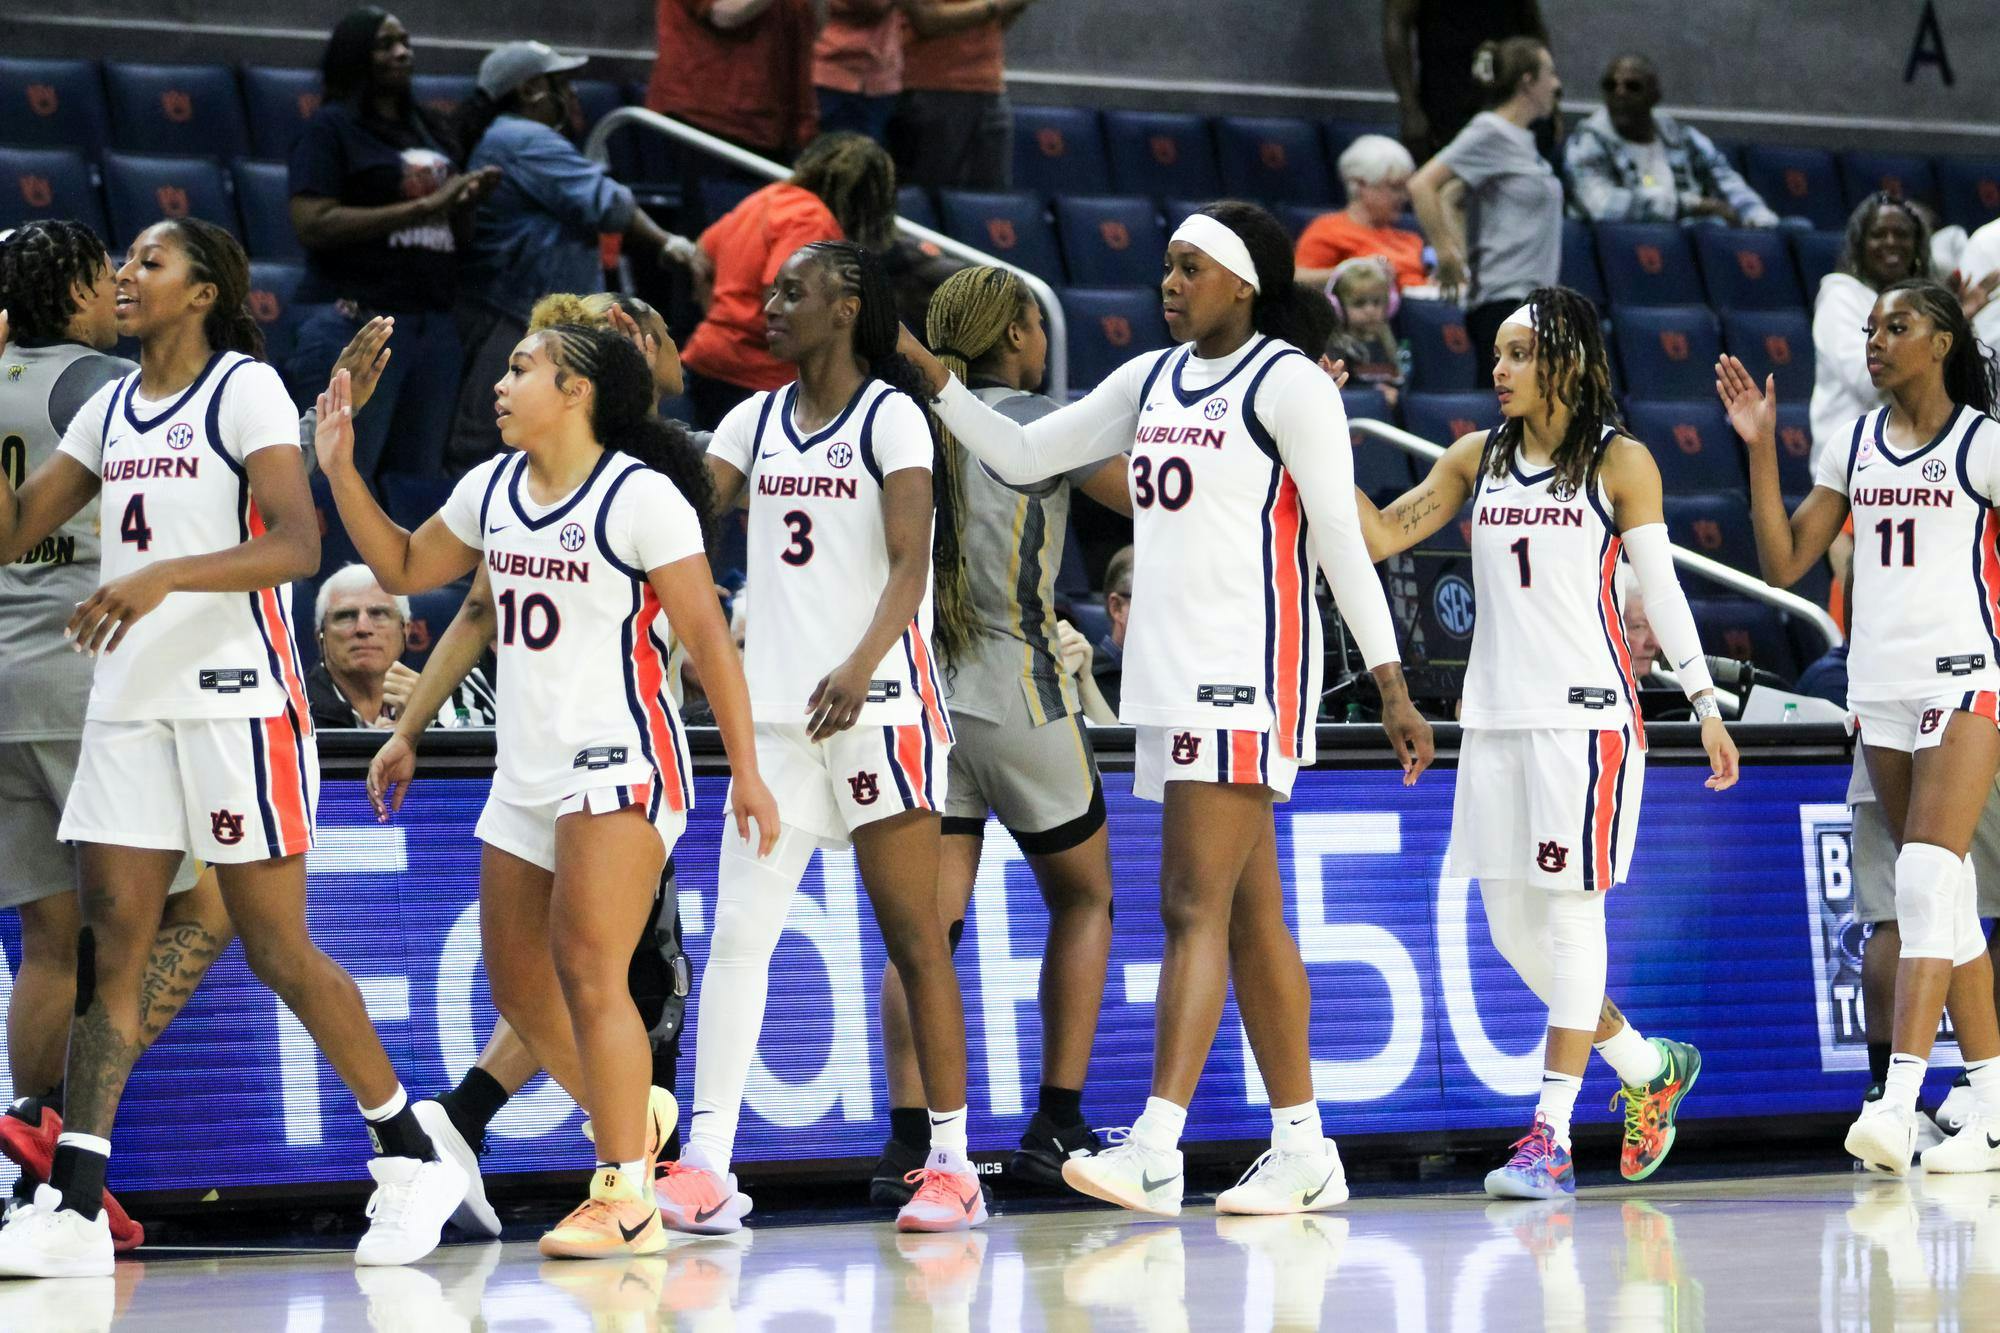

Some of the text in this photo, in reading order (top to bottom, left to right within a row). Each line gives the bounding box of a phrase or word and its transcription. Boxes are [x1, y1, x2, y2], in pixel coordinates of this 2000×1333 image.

[168, 424, 193, 449] SEC
[1136, 426, 1227, 450] AUBURN
[828, 443, 852, 468] SEC
[102, 456, 200, 482] AUBURN
[757, 474, 858, 499] AUBURN
[1132, 455, 1194, 512] 30
[1853, 487, 1954, 508] AUBURN
[120, 492, 152, 552] 4
[1478, 506, 1584, 528] AUBURN
[560, 523, 585, 551] SEC
[780, 509, 815, 567] 3
[1875, 518, 1916, 567] 11
[488, 549, 590, 583] AUBURN
[1510, 537, 1532, 588] 1
[498, 588, 561, 651] 10
[1438, 581, 1475, 635] SEC
[1973, 657, 1983, 667] 42
[243, 674, 255, 683] 44
[888, 685, 898, 694] 44
[1237, 690, 1248, 699] 48
[1606, 693, 1615, 702] 42
[612, 751, 623, 760] 44
